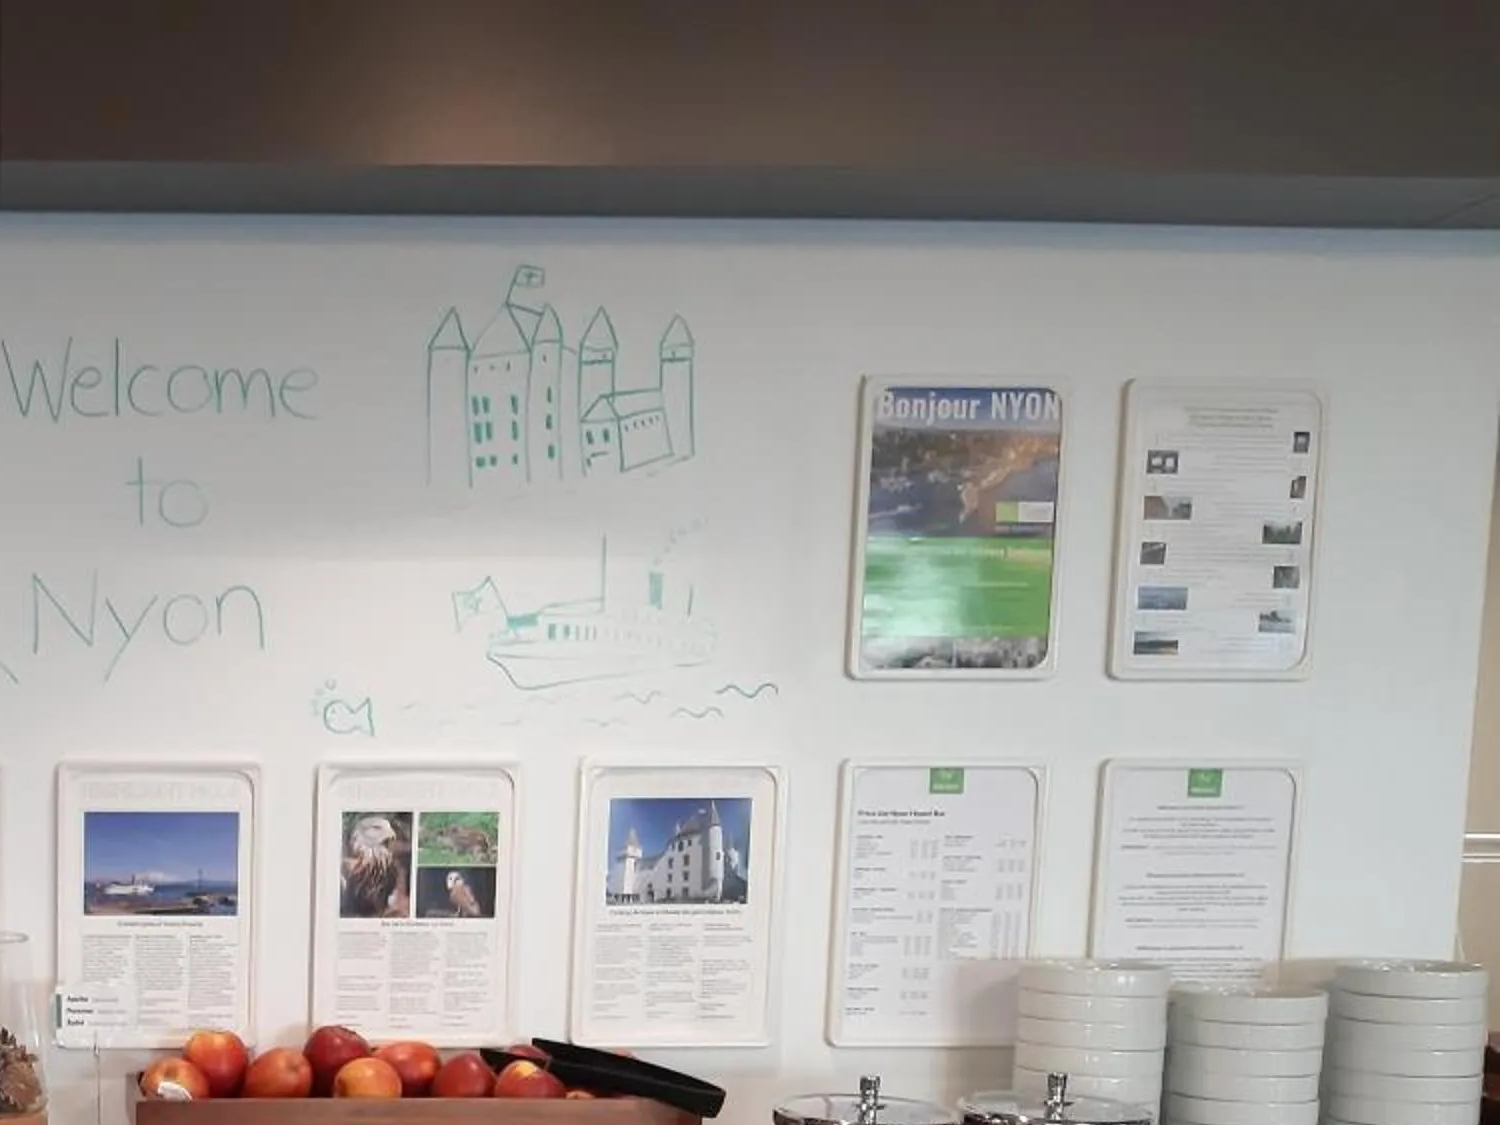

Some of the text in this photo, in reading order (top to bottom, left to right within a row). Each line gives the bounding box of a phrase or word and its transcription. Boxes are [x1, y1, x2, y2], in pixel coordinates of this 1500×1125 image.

[1, 336, 321, 423] Welcome
[877, 391, 1059, 426] Bonjour NYON
[124, 456, 209, 528] to
[30, 568, 266, 683] Nyon
